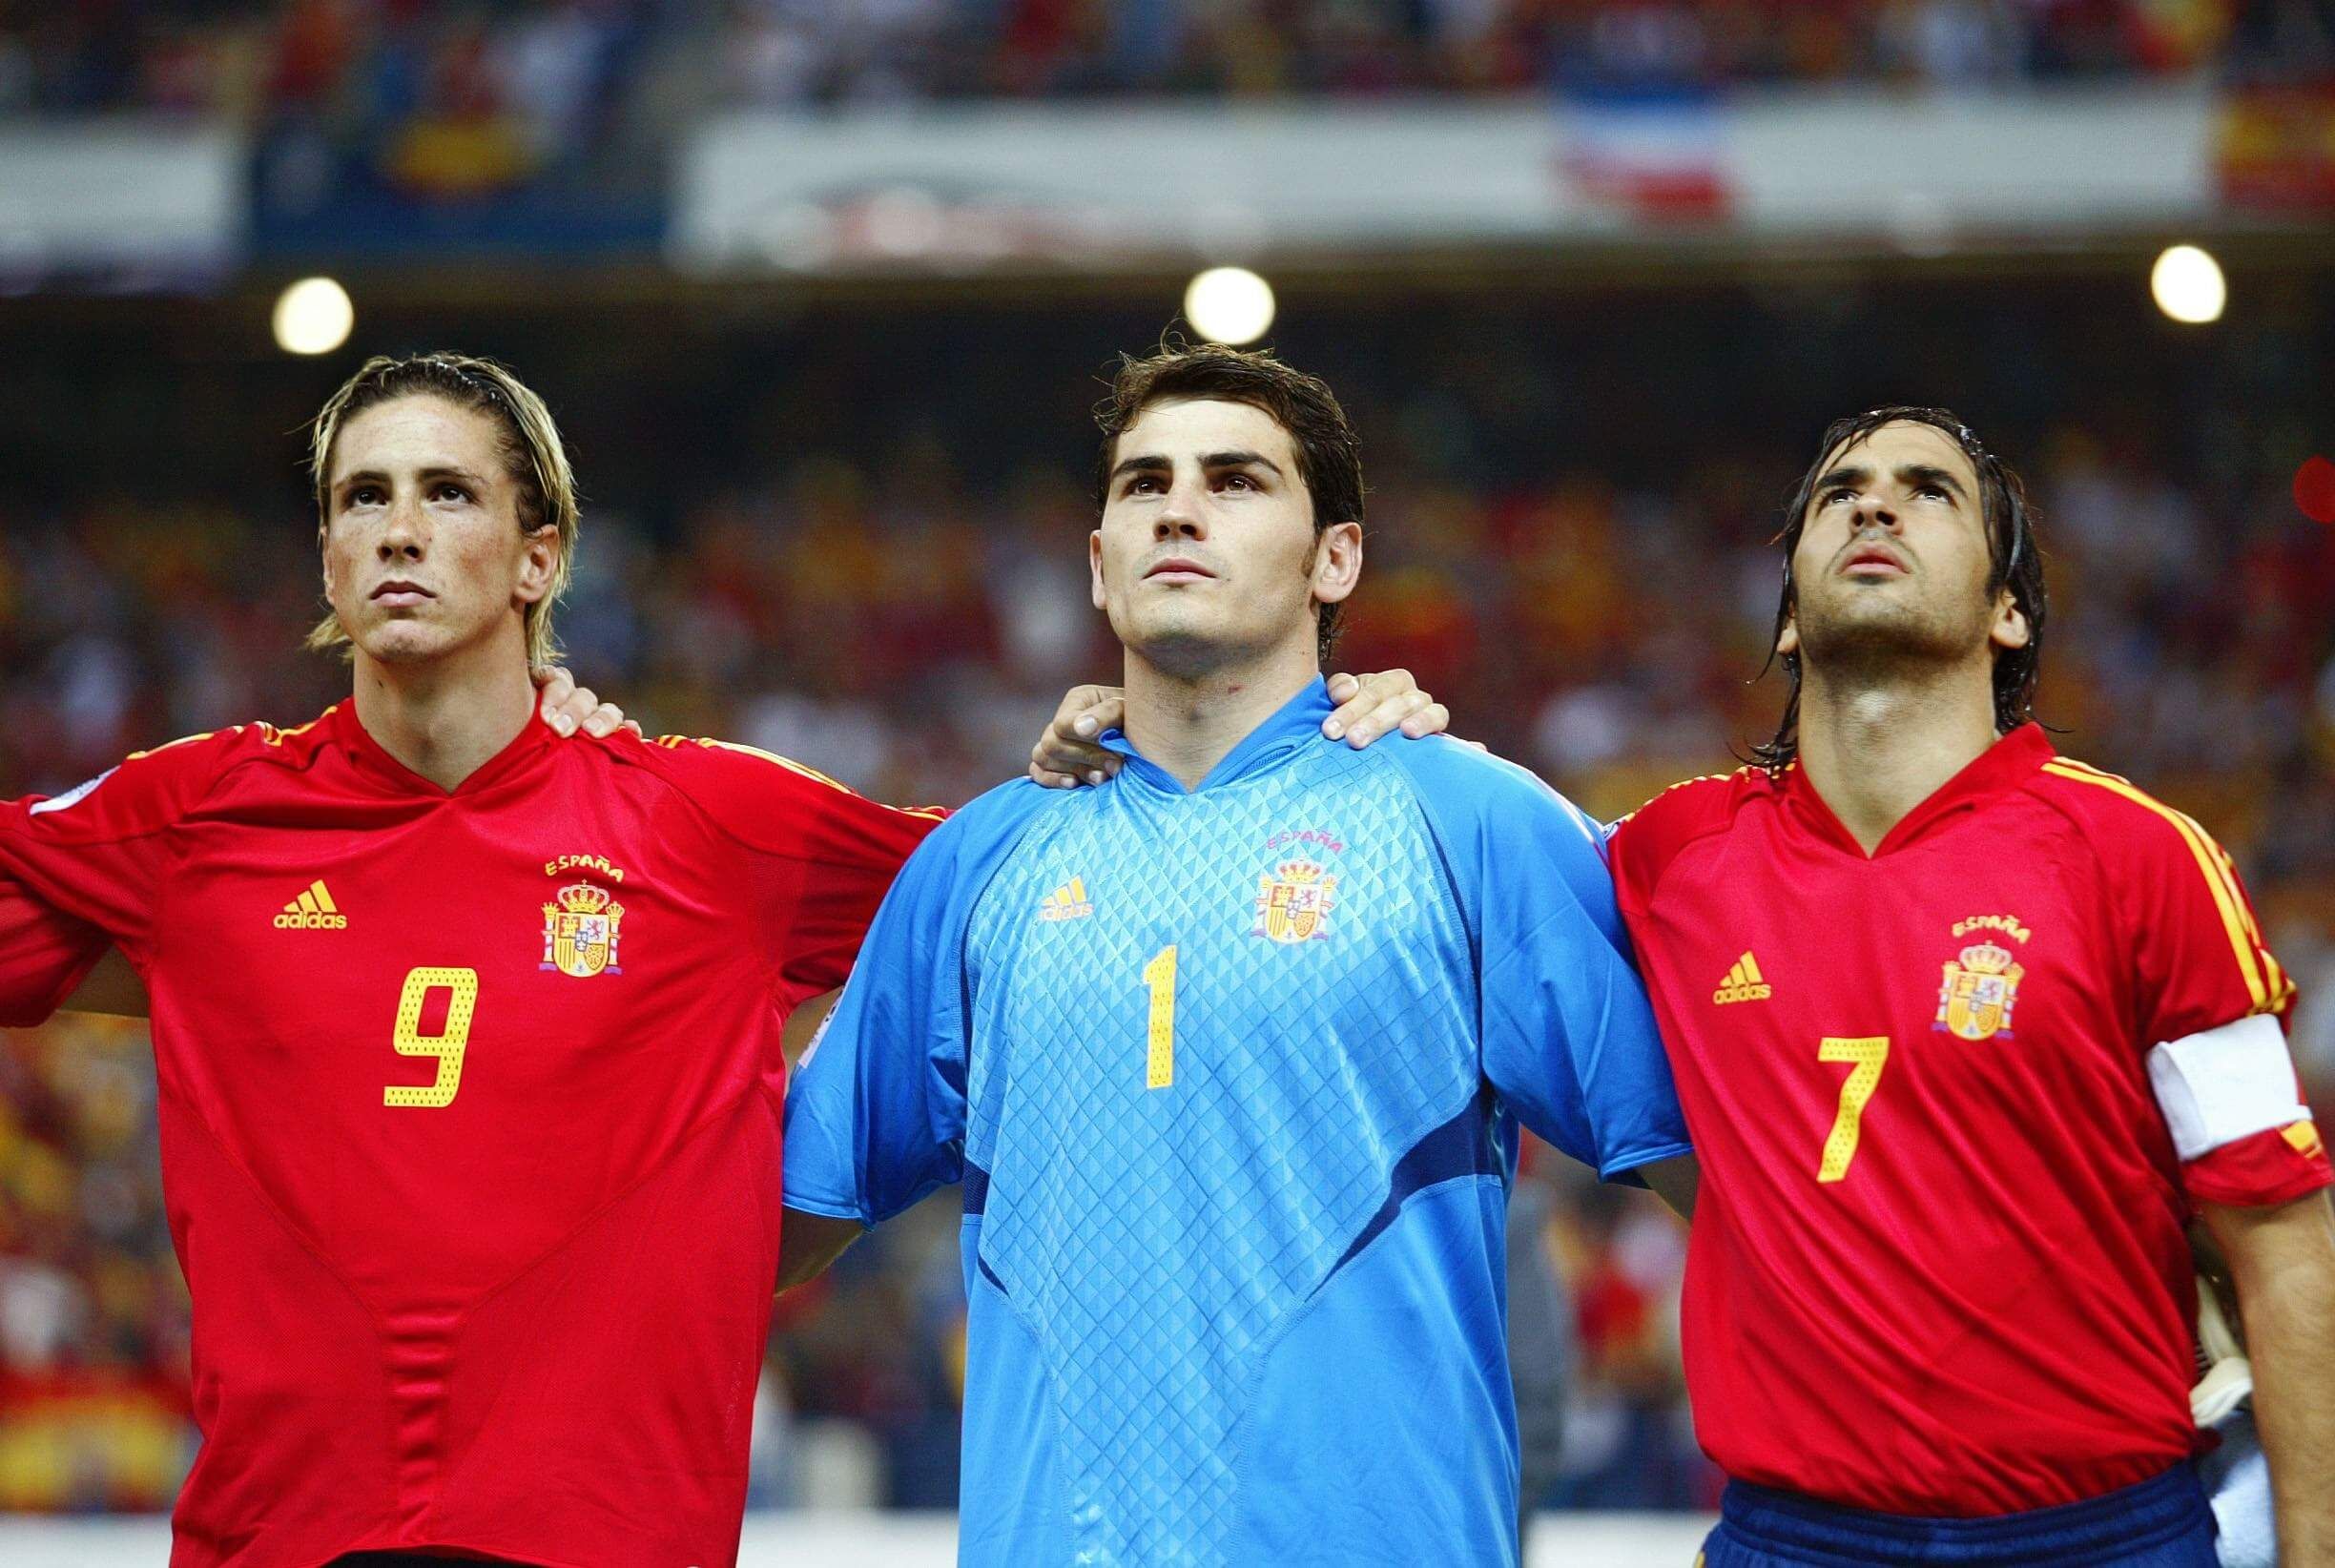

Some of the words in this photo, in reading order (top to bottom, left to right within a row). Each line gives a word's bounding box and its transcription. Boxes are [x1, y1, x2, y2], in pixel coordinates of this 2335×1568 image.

[545, 855, 625, 883] ESPAÑA
[273, 910, 347, 930] adidas
[1952, 914, 2031, 944] ESPAÑA
[1713, 982, 1772, 1005] adidas
[1144, 945, 1177, 1090] 1
[383, 966, 478, 1108] 9
[1816, 1037, 1890, 1183] 7
